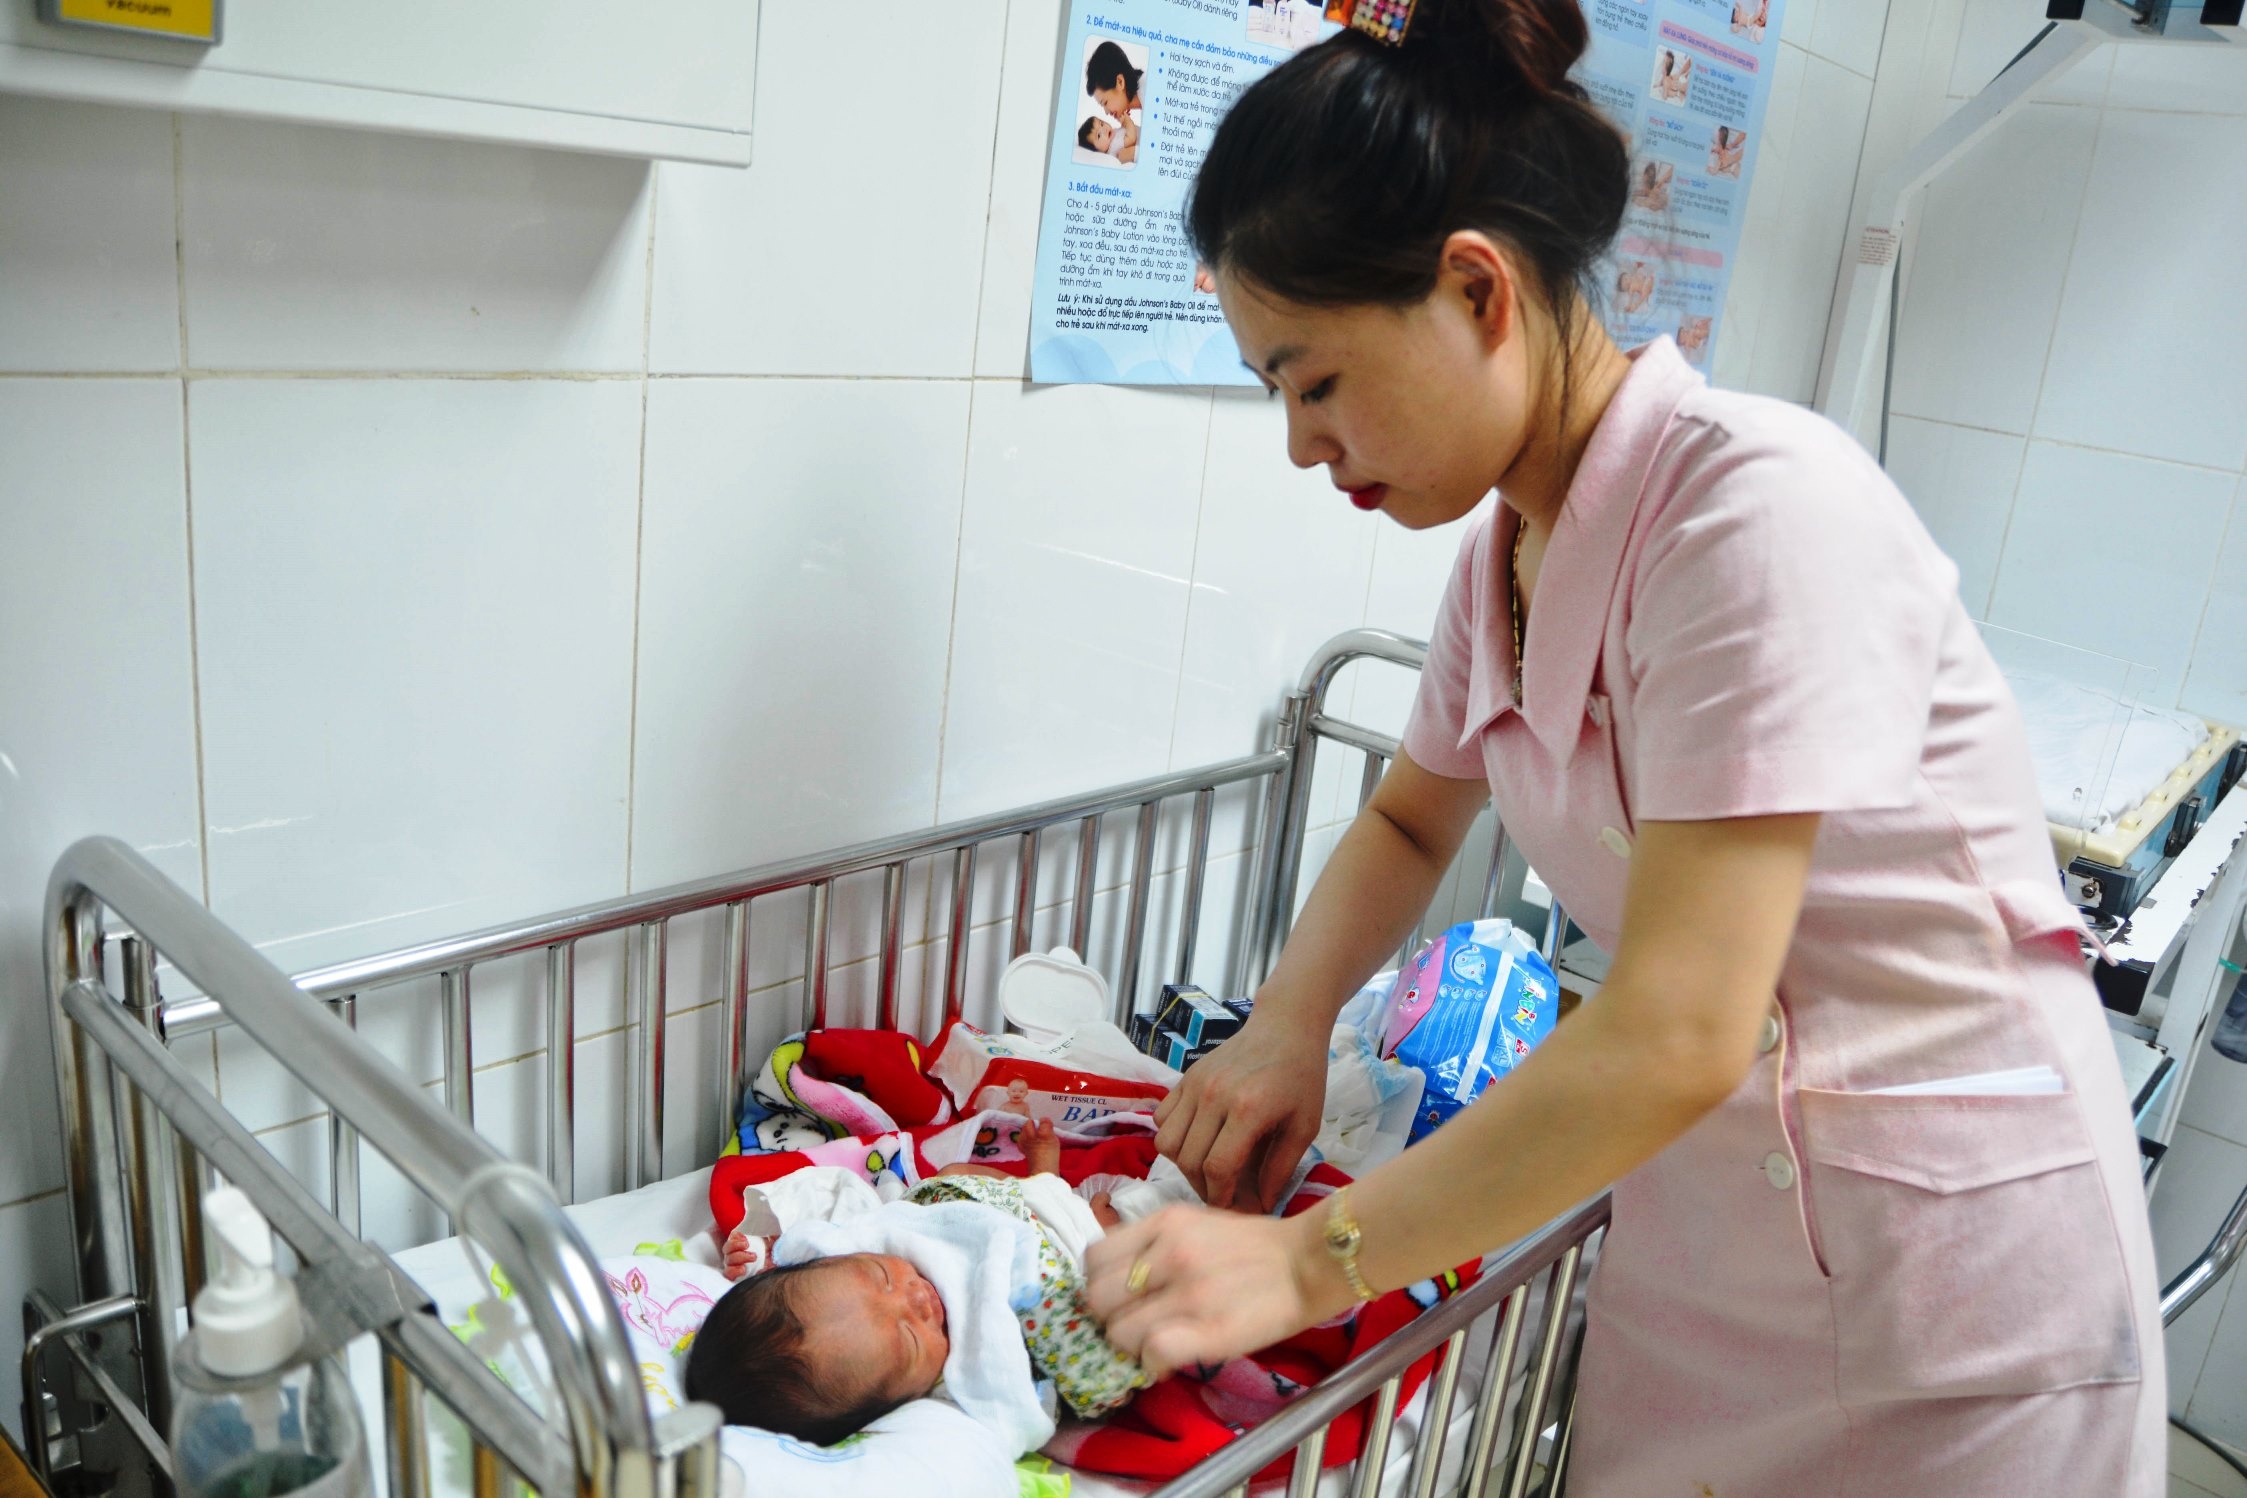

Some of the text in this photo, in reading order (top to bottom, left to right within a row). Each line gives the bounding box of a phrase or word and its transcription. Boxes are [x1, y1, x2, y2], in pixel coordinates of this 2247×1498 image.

[1105, 20, 1131, 33] mát-xa
[1132, 25, 1147, 38] hiệu
[1165, 34, 1178, 44] cha
[1179, 39, 1190, 49] mẹ
[1170, 51, 1180, 62] Hai
[1182, 54, 1194, 66] tay
[1168, 67, 1189, 82] Không
[1201, 104, 1219, 117] trong
[1068, 181, 1074, 191] 3.
[1067, 198, 1082, 208] Cho
[1084, 200, 1089, 209] 4
[1095, 202, 1100, 211] 5
[1134, 206, 1168, 219] Johnson's
[1065, 211, 1084, 223] hoặc
[1064, 225, 1099, 237] Johnson's
[1101, 228, 1120, 240] Baby
[1123, 230, 1144, 241] Lotion
[1080, 241, 1093, 249] xoa
[1114, 244, 1127, 253] sau
[1166, 248, 1178, 257] cho
[1062, 250, 1076, 262] Tiếp
[1119, 255, 1137, 266] thêm
[1103, 267, 1113, 276] khi
[1116, 268, 1128, 279] tay
[1155, 272, 1170, 282] trong
[1082, 294, 1093, 304] Khi
[1105, 296, 1122, 307] dụng
[1139, 298, 1168, 308] Johnson's
[1170, 300, 1186, 310] Baby
[1078, 307, 1096, 318] hoặc
[1175, 312, 1188, 321] Nên
[1056, 318, 1148, 333] cho trẻ sau khi mát-xa xong.
[1049, 1037, 1074, 1054] PE
[1051, 1094, 1069, 1102] WET
[1070, 1096, 1096, 1105] TISSUE
